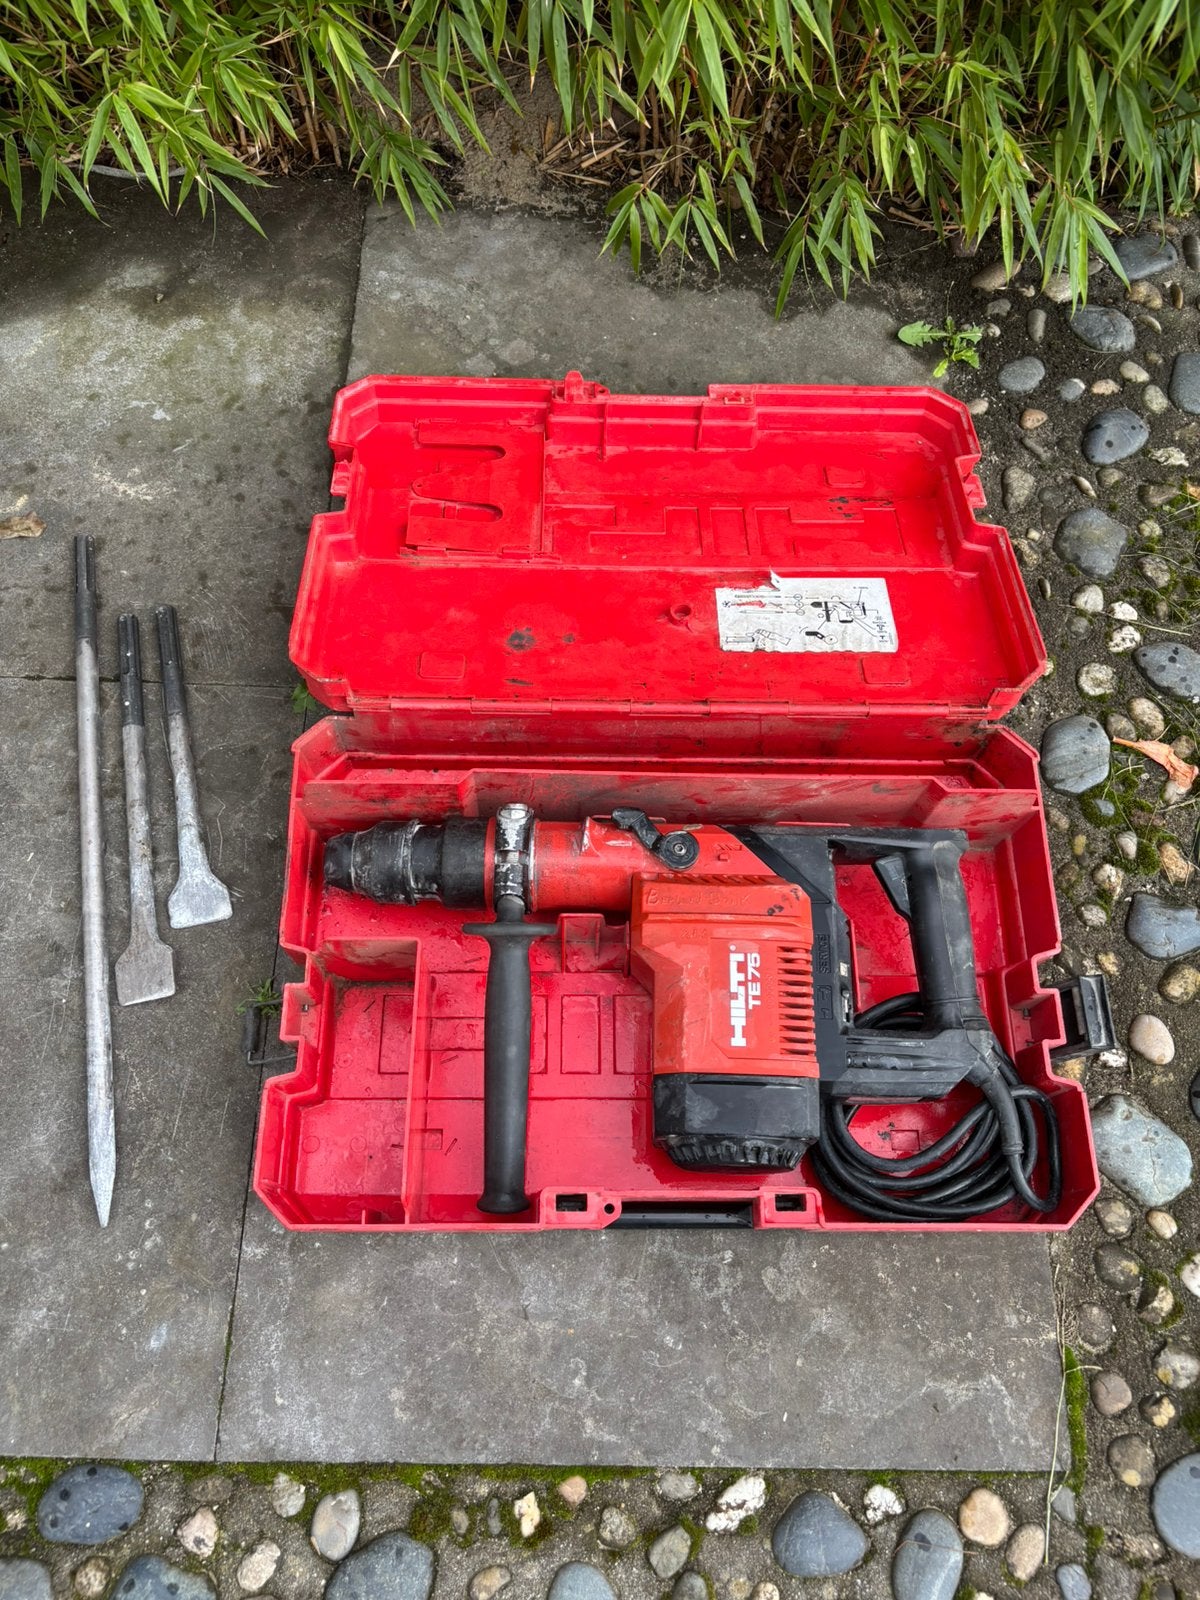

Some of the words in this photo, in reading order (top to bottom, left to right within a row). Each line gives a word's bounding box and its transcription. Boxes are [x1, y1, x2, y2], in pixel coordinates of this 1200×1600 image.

[747, 952, 761, 980] 75
[729, 952, 747, 1047] HILTI
[748, 981, 761, 1010] TE
